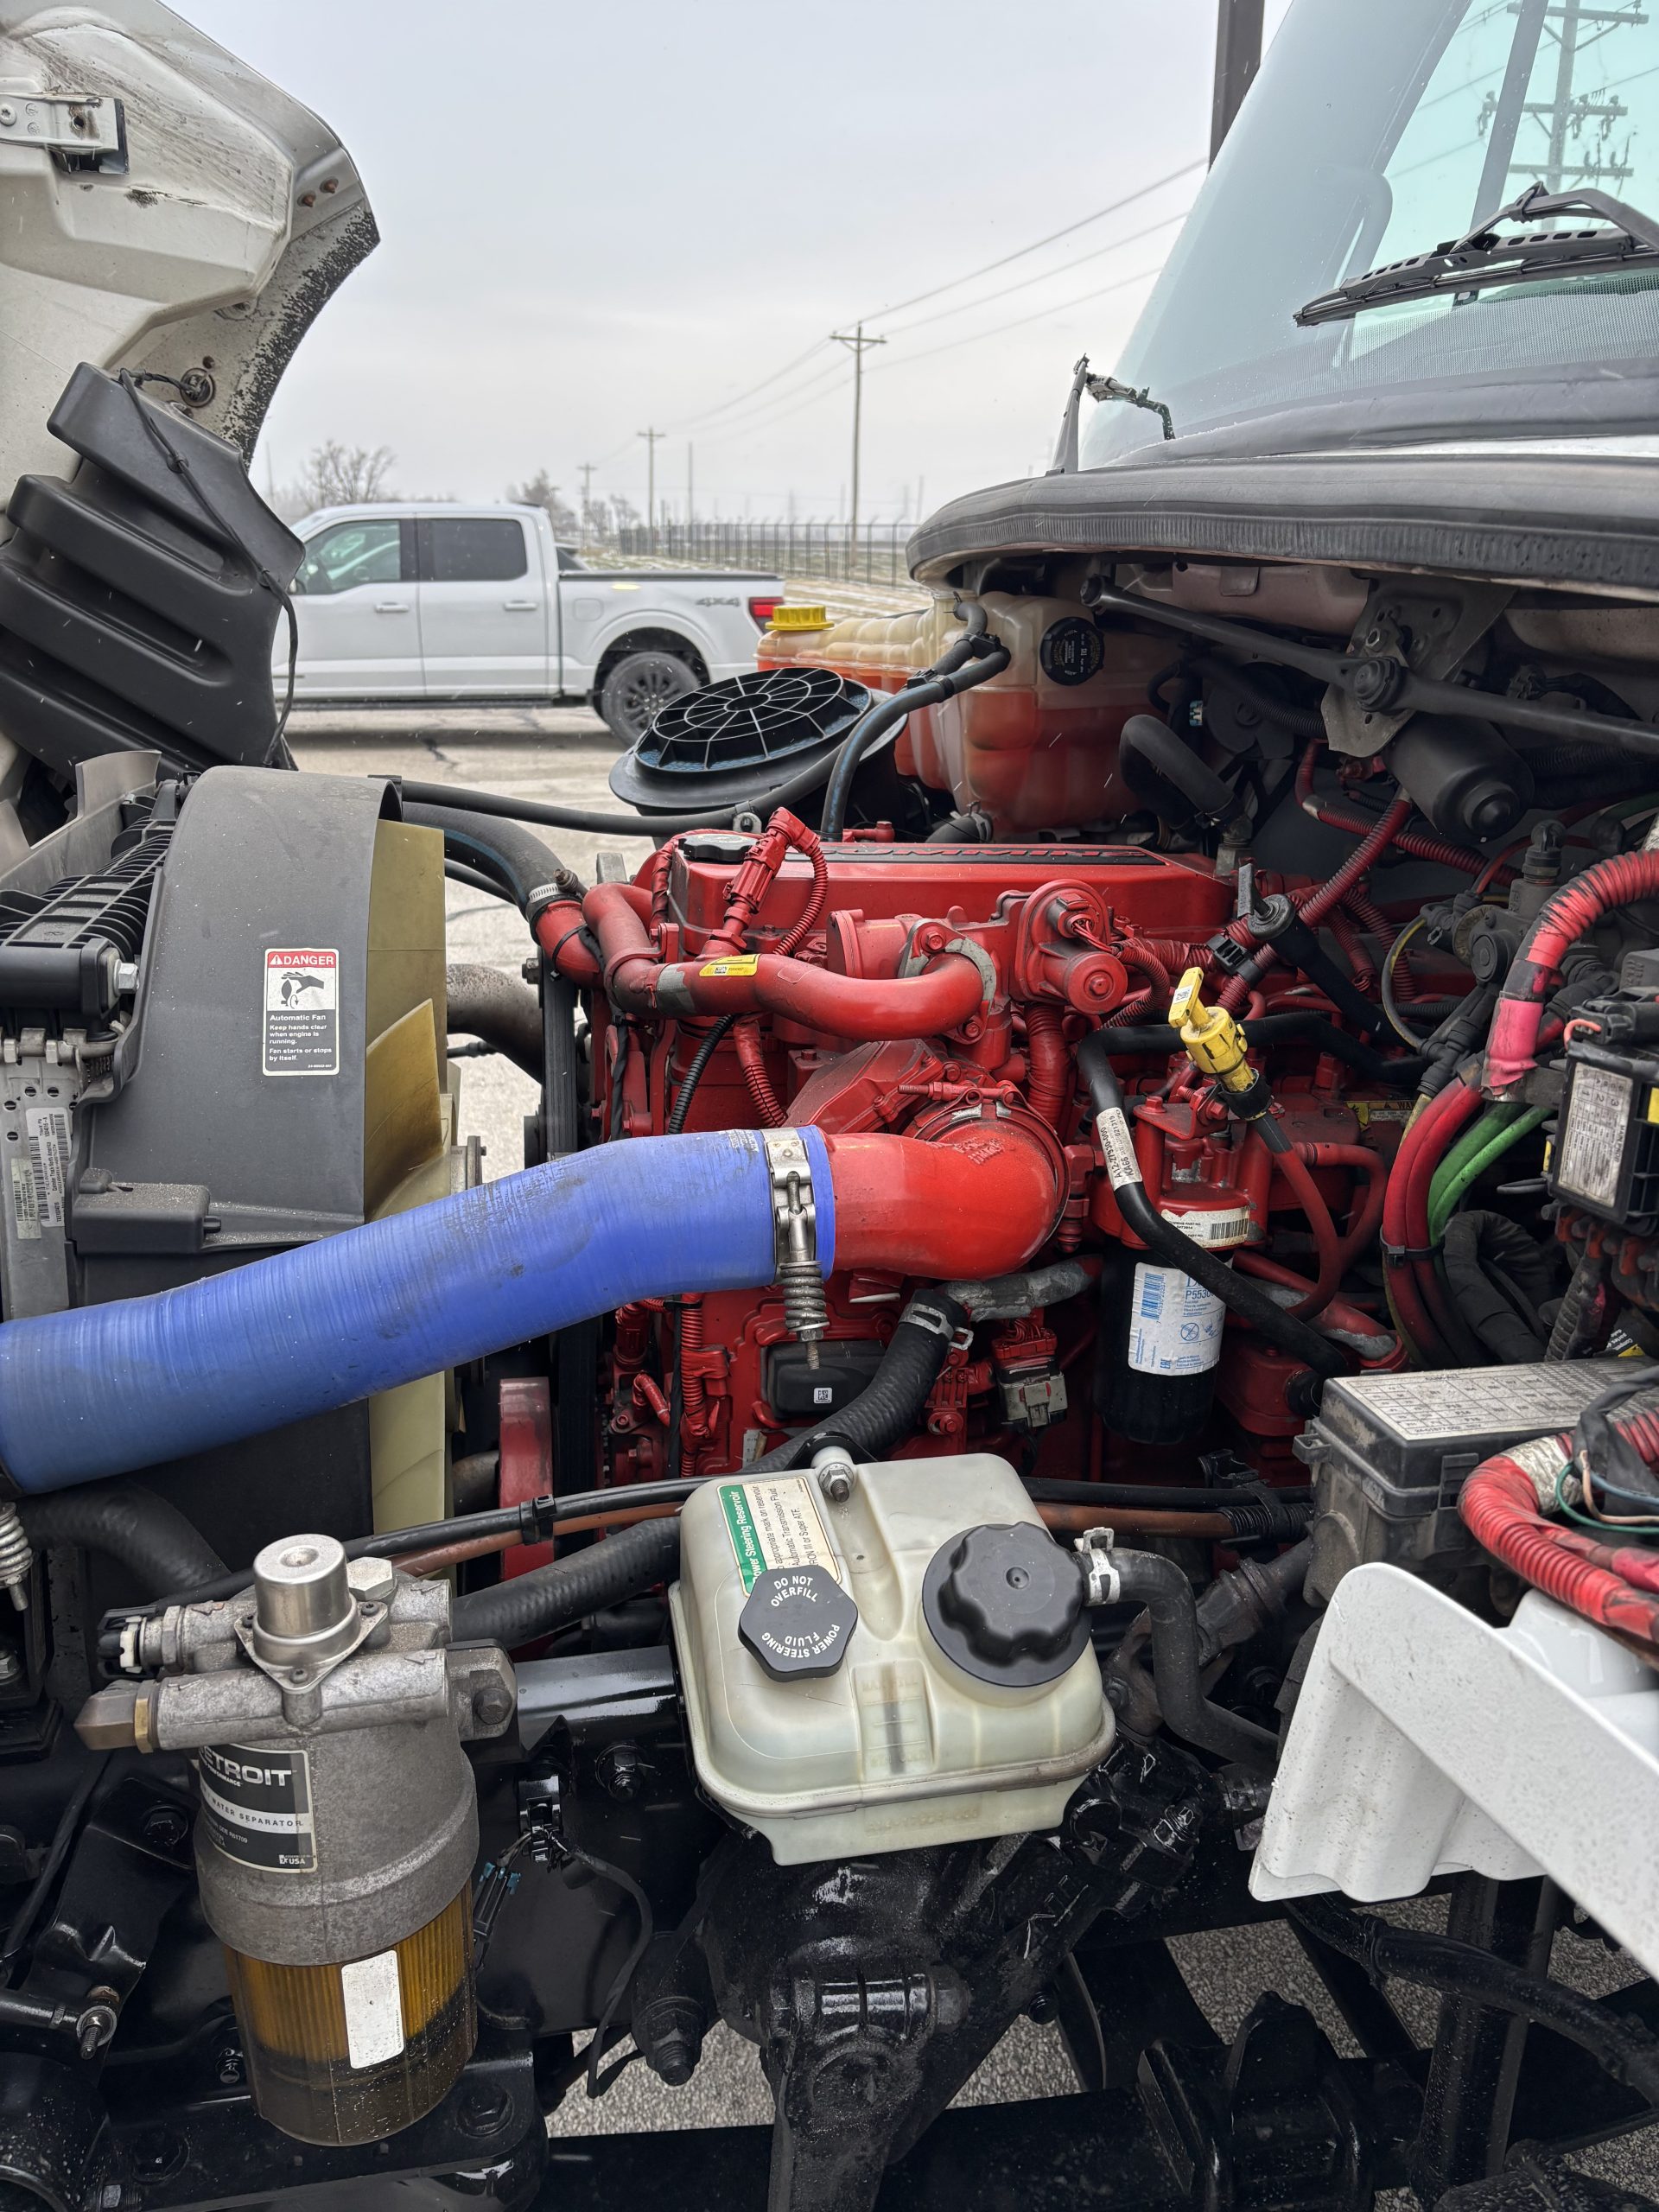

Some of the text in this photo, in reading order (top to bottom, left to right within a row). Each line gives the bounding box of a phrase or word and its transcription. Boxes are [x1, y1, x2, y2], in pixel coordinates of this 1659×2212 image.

[283, 956, 334, 965] DANGER
[1611, 1098, 1619, 1107] 3
[1185, 1287, 1217, 1300] P5530
[729, 1491, 747, 1524] Reservoir
[762, 1516, 772, 1532] mark
[770, 1488, 800, 1566] Automatic Transmission Fluid
[798, 1520, 809, 1537] Super
[741, 1524, 756, 1556] Steering
[767, 1532, 784, 1564] appropriate
[774, 1576, 813, 1590] DO NOT
[771, 1586, 817, 1607] OVERFILL
[761, 1624, 840, 1658] POWER STEERING
[785, 1632, 820, 1647] FLUID
[239, 1813, 303, 1827] SEPARATOR
